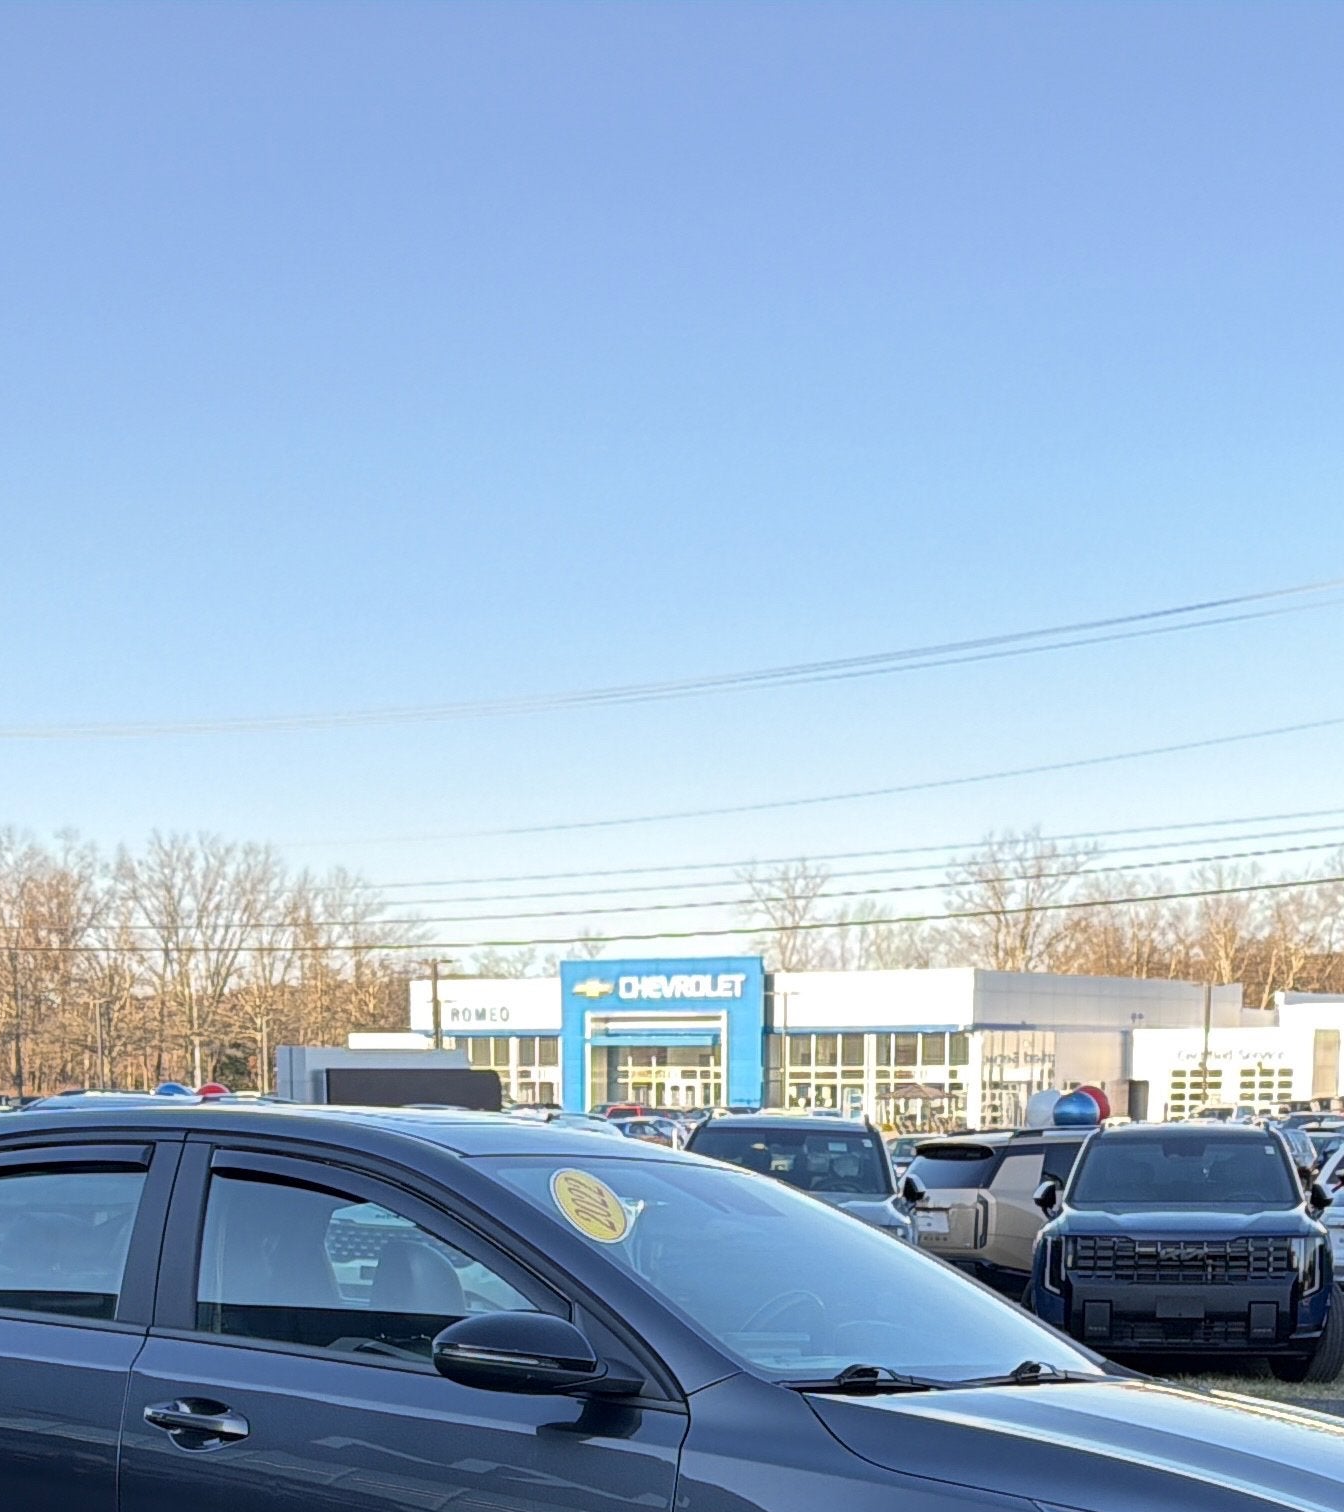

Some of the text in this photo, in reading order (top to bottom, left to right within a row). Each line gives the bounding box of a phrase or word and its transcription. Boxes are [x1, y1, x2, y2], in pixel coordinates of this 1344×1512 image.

[618, 974, 745, 999] CHEVROLET
[450, 1006, 510, 1022] ROMEO
[564, 1177, 617, 1232] 2022
